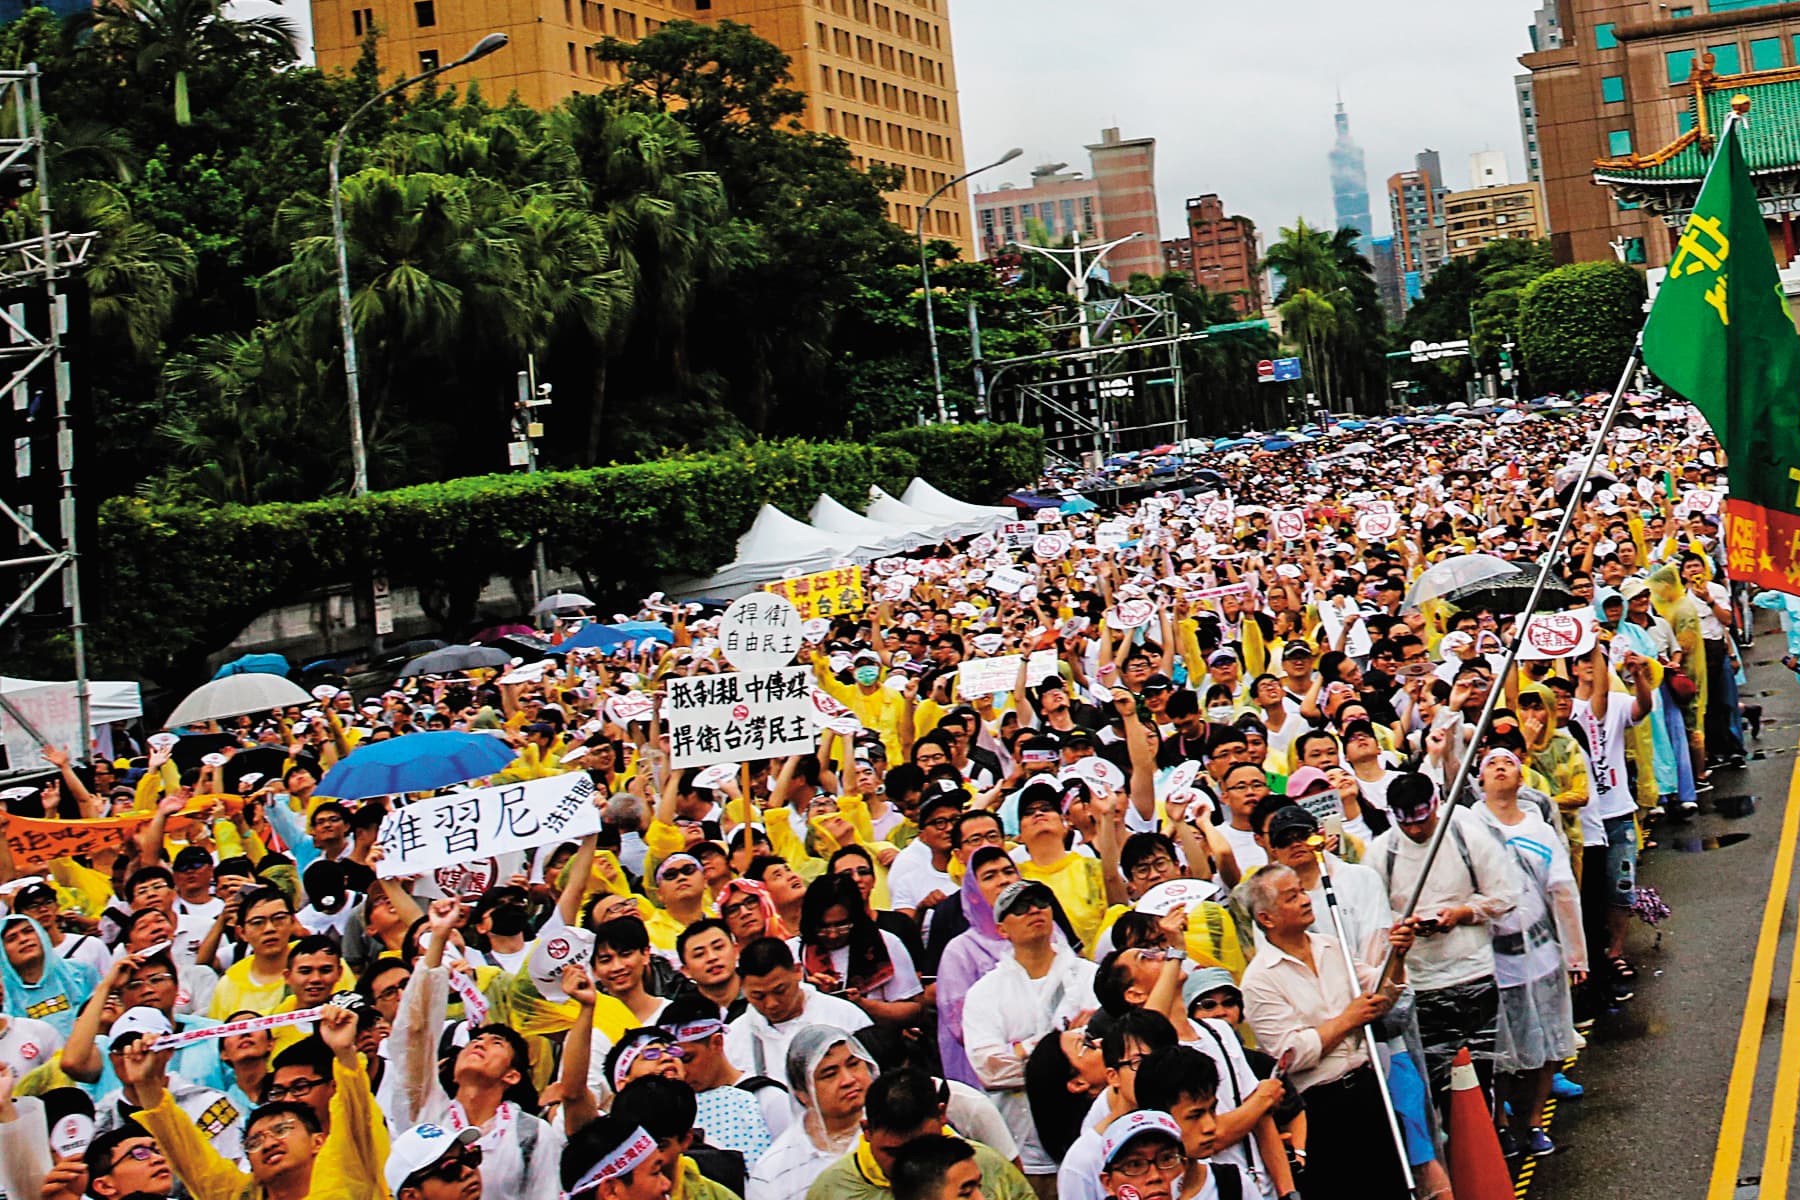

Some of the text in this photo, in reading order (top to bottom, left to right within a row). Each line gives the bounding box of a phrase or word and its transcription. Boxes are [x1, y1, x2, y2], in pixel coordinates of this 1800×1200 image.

[732, 602, 791, 628] 捍衛
[726, 630, 796, 655] 自由民主
[670, 670, 811, 710] 抵制親中傳媒
[671, 714, 810, 758] 捍衛台灣民主
[378, 785, 541, 863] 維習尼
